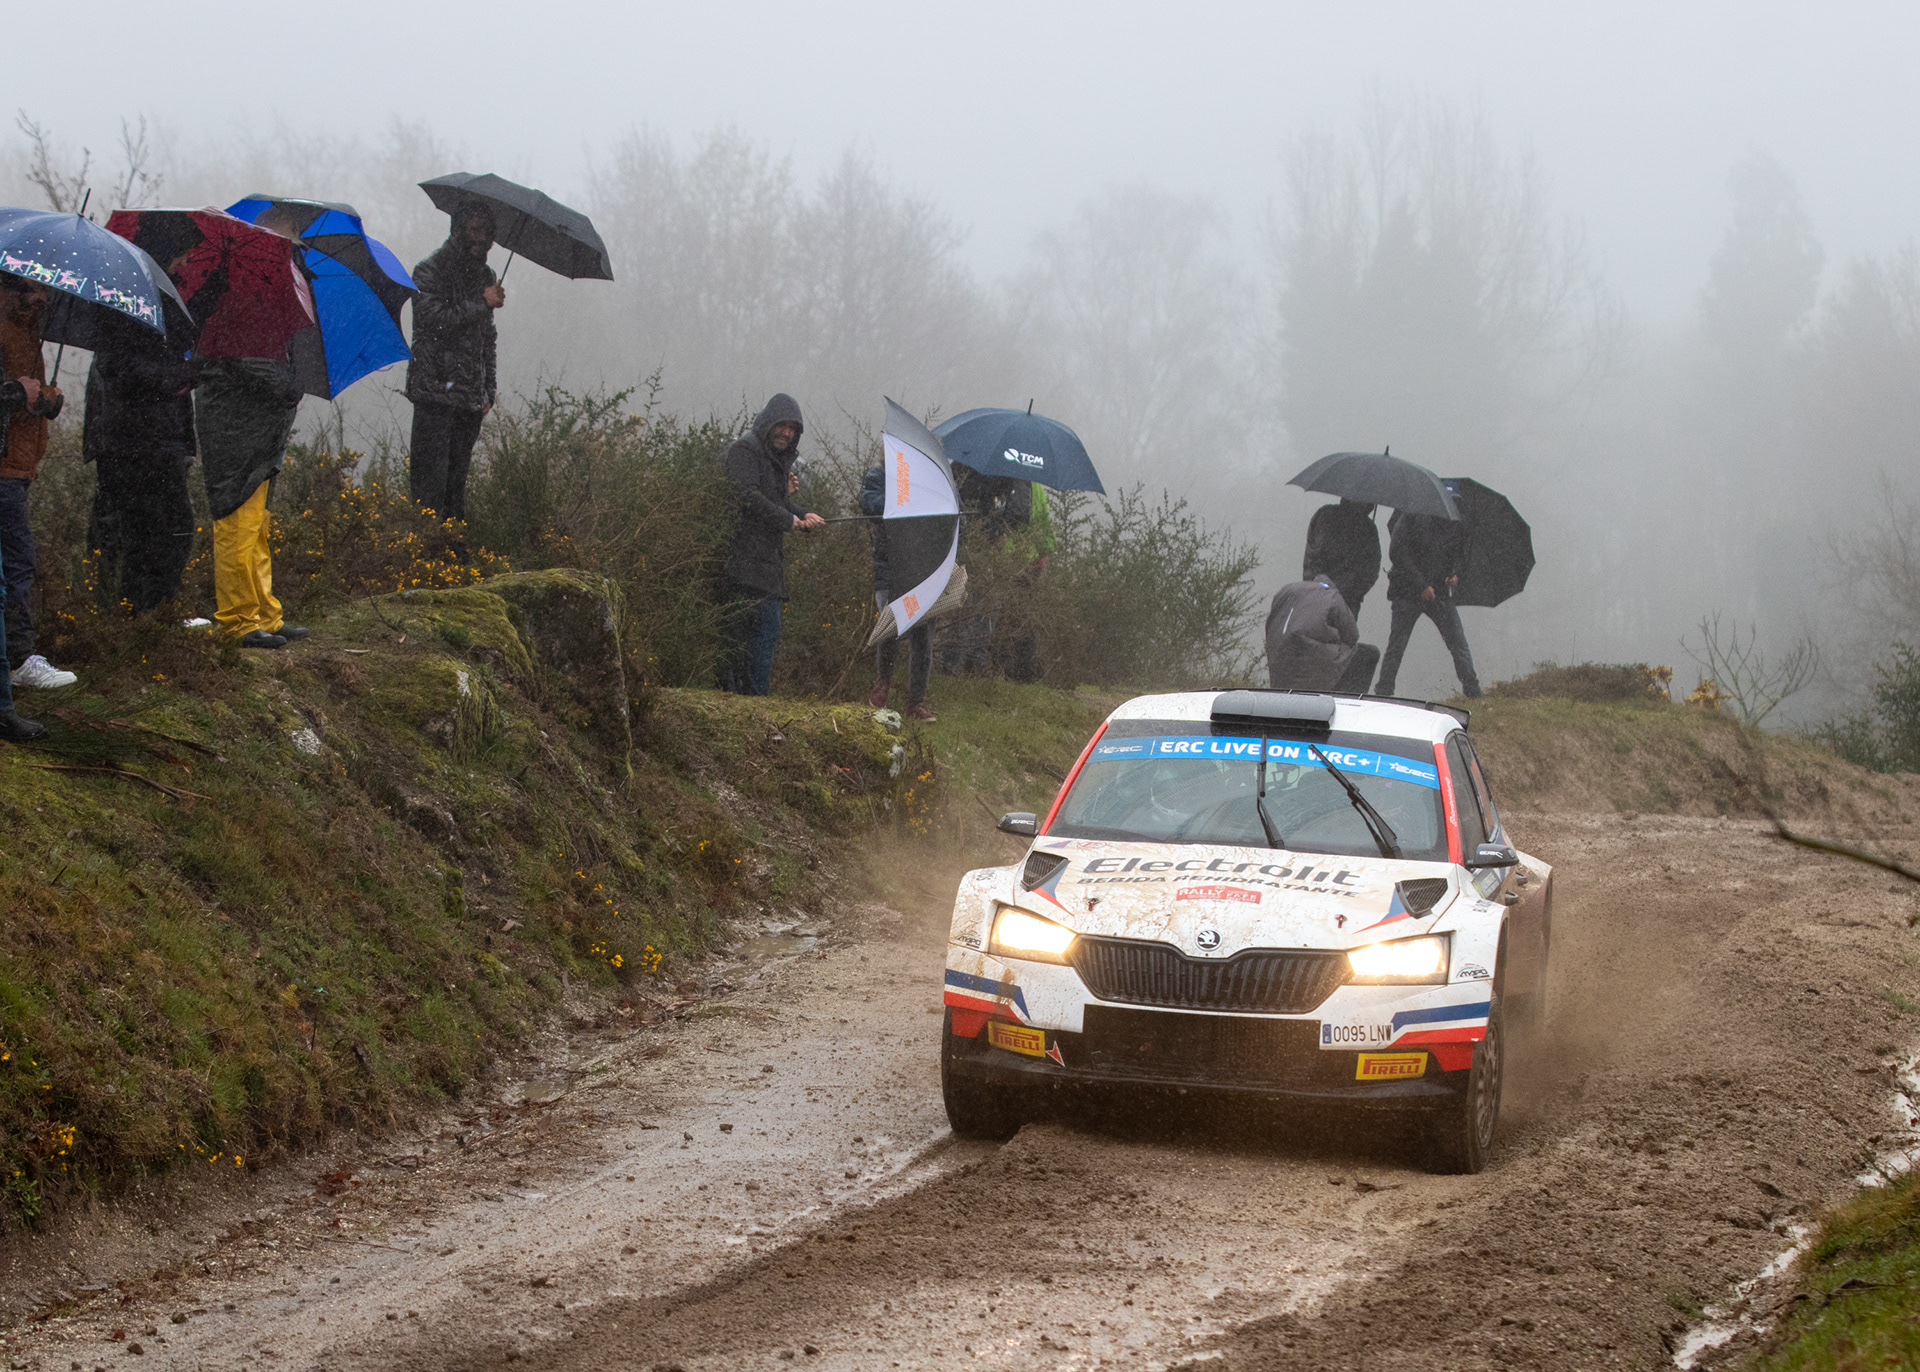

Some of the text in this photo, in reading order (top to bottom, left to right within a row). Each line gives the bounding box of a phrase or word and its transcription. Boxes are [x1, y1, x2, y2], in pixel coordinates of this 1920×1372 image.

[1020, 452, 1044, 465] TCM
[1160, 741, 1204, 753] ERC
[1210, 742, 1261, 755] LIVE
[1268, 744, 1300, 759] ON
[1397, 764, 1436, 781] ERC
[1083, 857, 1360, 886] Electrolit
[1076, 875, 1360, 897] BEBIDA REHIDRATANTE
[1179, 888, 1223, 896] RALLY
[993, 1026, 1040, 1051] PIRELLI
[1333, 1024, 1392, 1042] 0095 LNW
[1363, 1058, 1422, 1075] PIRELLI
